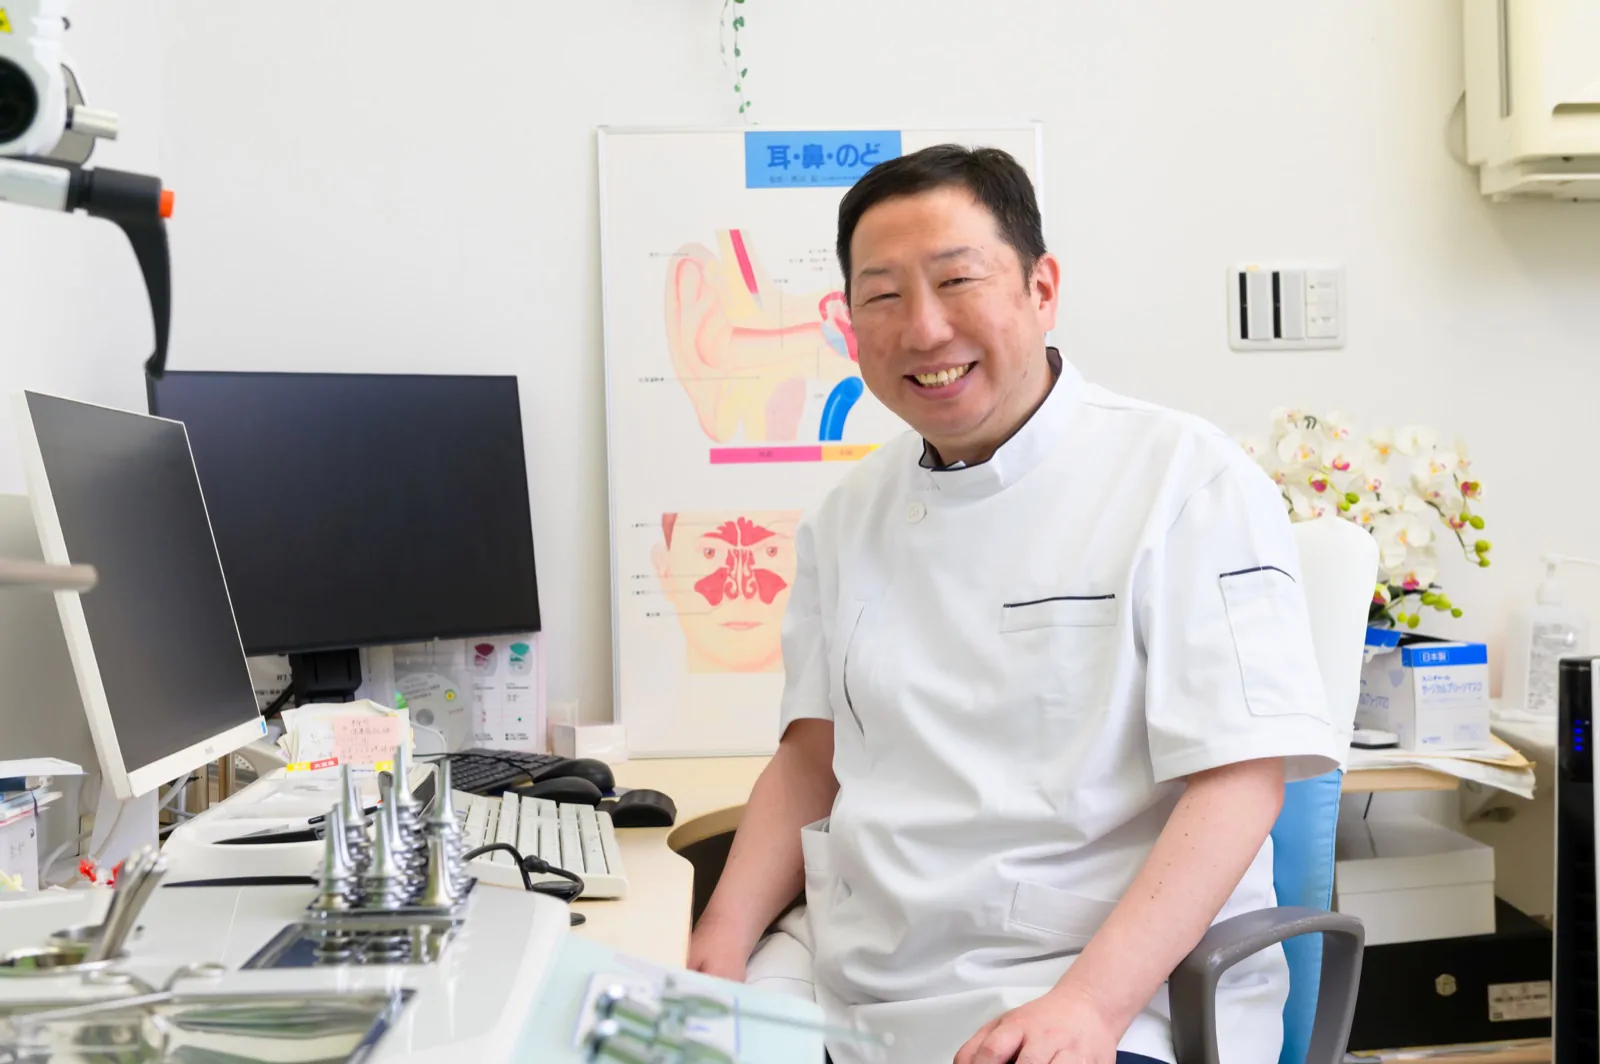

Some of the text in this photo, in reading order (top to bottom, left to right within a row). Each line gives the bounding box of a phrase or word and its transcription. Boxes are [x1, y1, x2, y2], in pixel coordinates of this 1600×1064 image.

[767, 142, 881, 170] 耳・鼻・のど
[1422, 651, 1447, 663] 日本製
